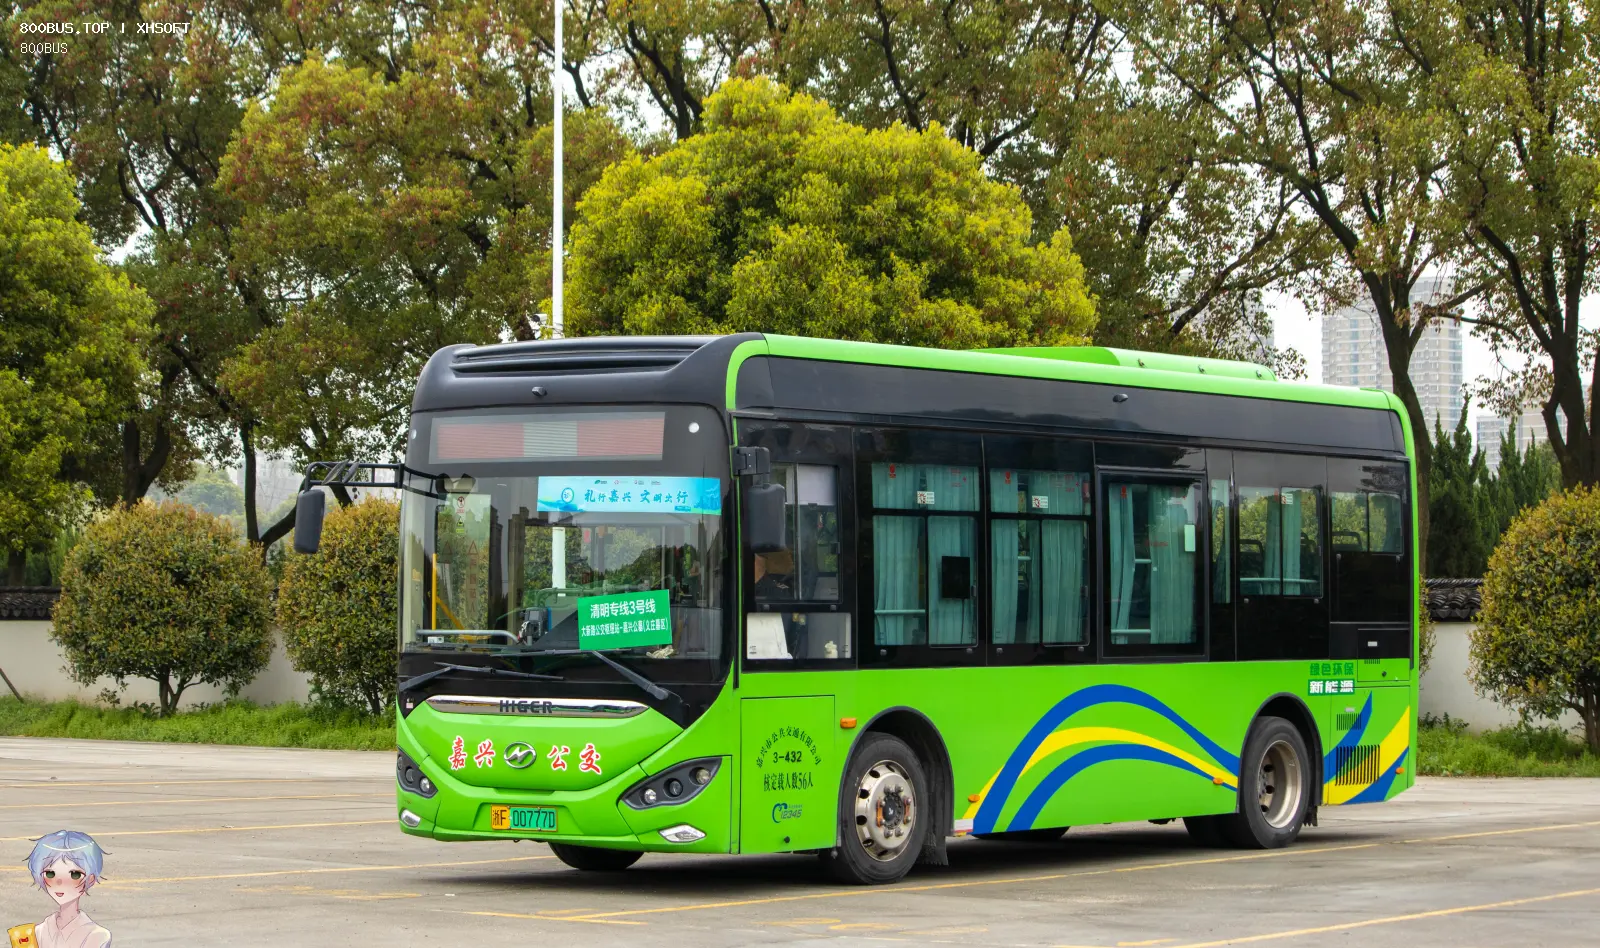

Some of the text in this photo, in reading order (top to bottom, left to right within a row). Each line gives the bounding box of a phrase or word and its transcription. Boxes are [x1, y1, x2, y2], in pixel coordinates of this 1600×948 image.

[584, 489, 689, 504] 礼行嘉兴 文明出行
[590, 598, 656, 619] 清明专线3号线
[1309, 662, 1354, 676] 绿色环保
[1309, 680, 1354, 694] 新能源
[499, 699, 553, 714] HIGER
[448, 735, 602, 774] 嘉兴 公交
[756, 726, 821, 768] 嘉兴市公共交通有限公司
[773, 751, 802, 764] 3-432
[763, 772, 813, 792] 核定载人数56人
[780, 809, 803, 819] 12345
